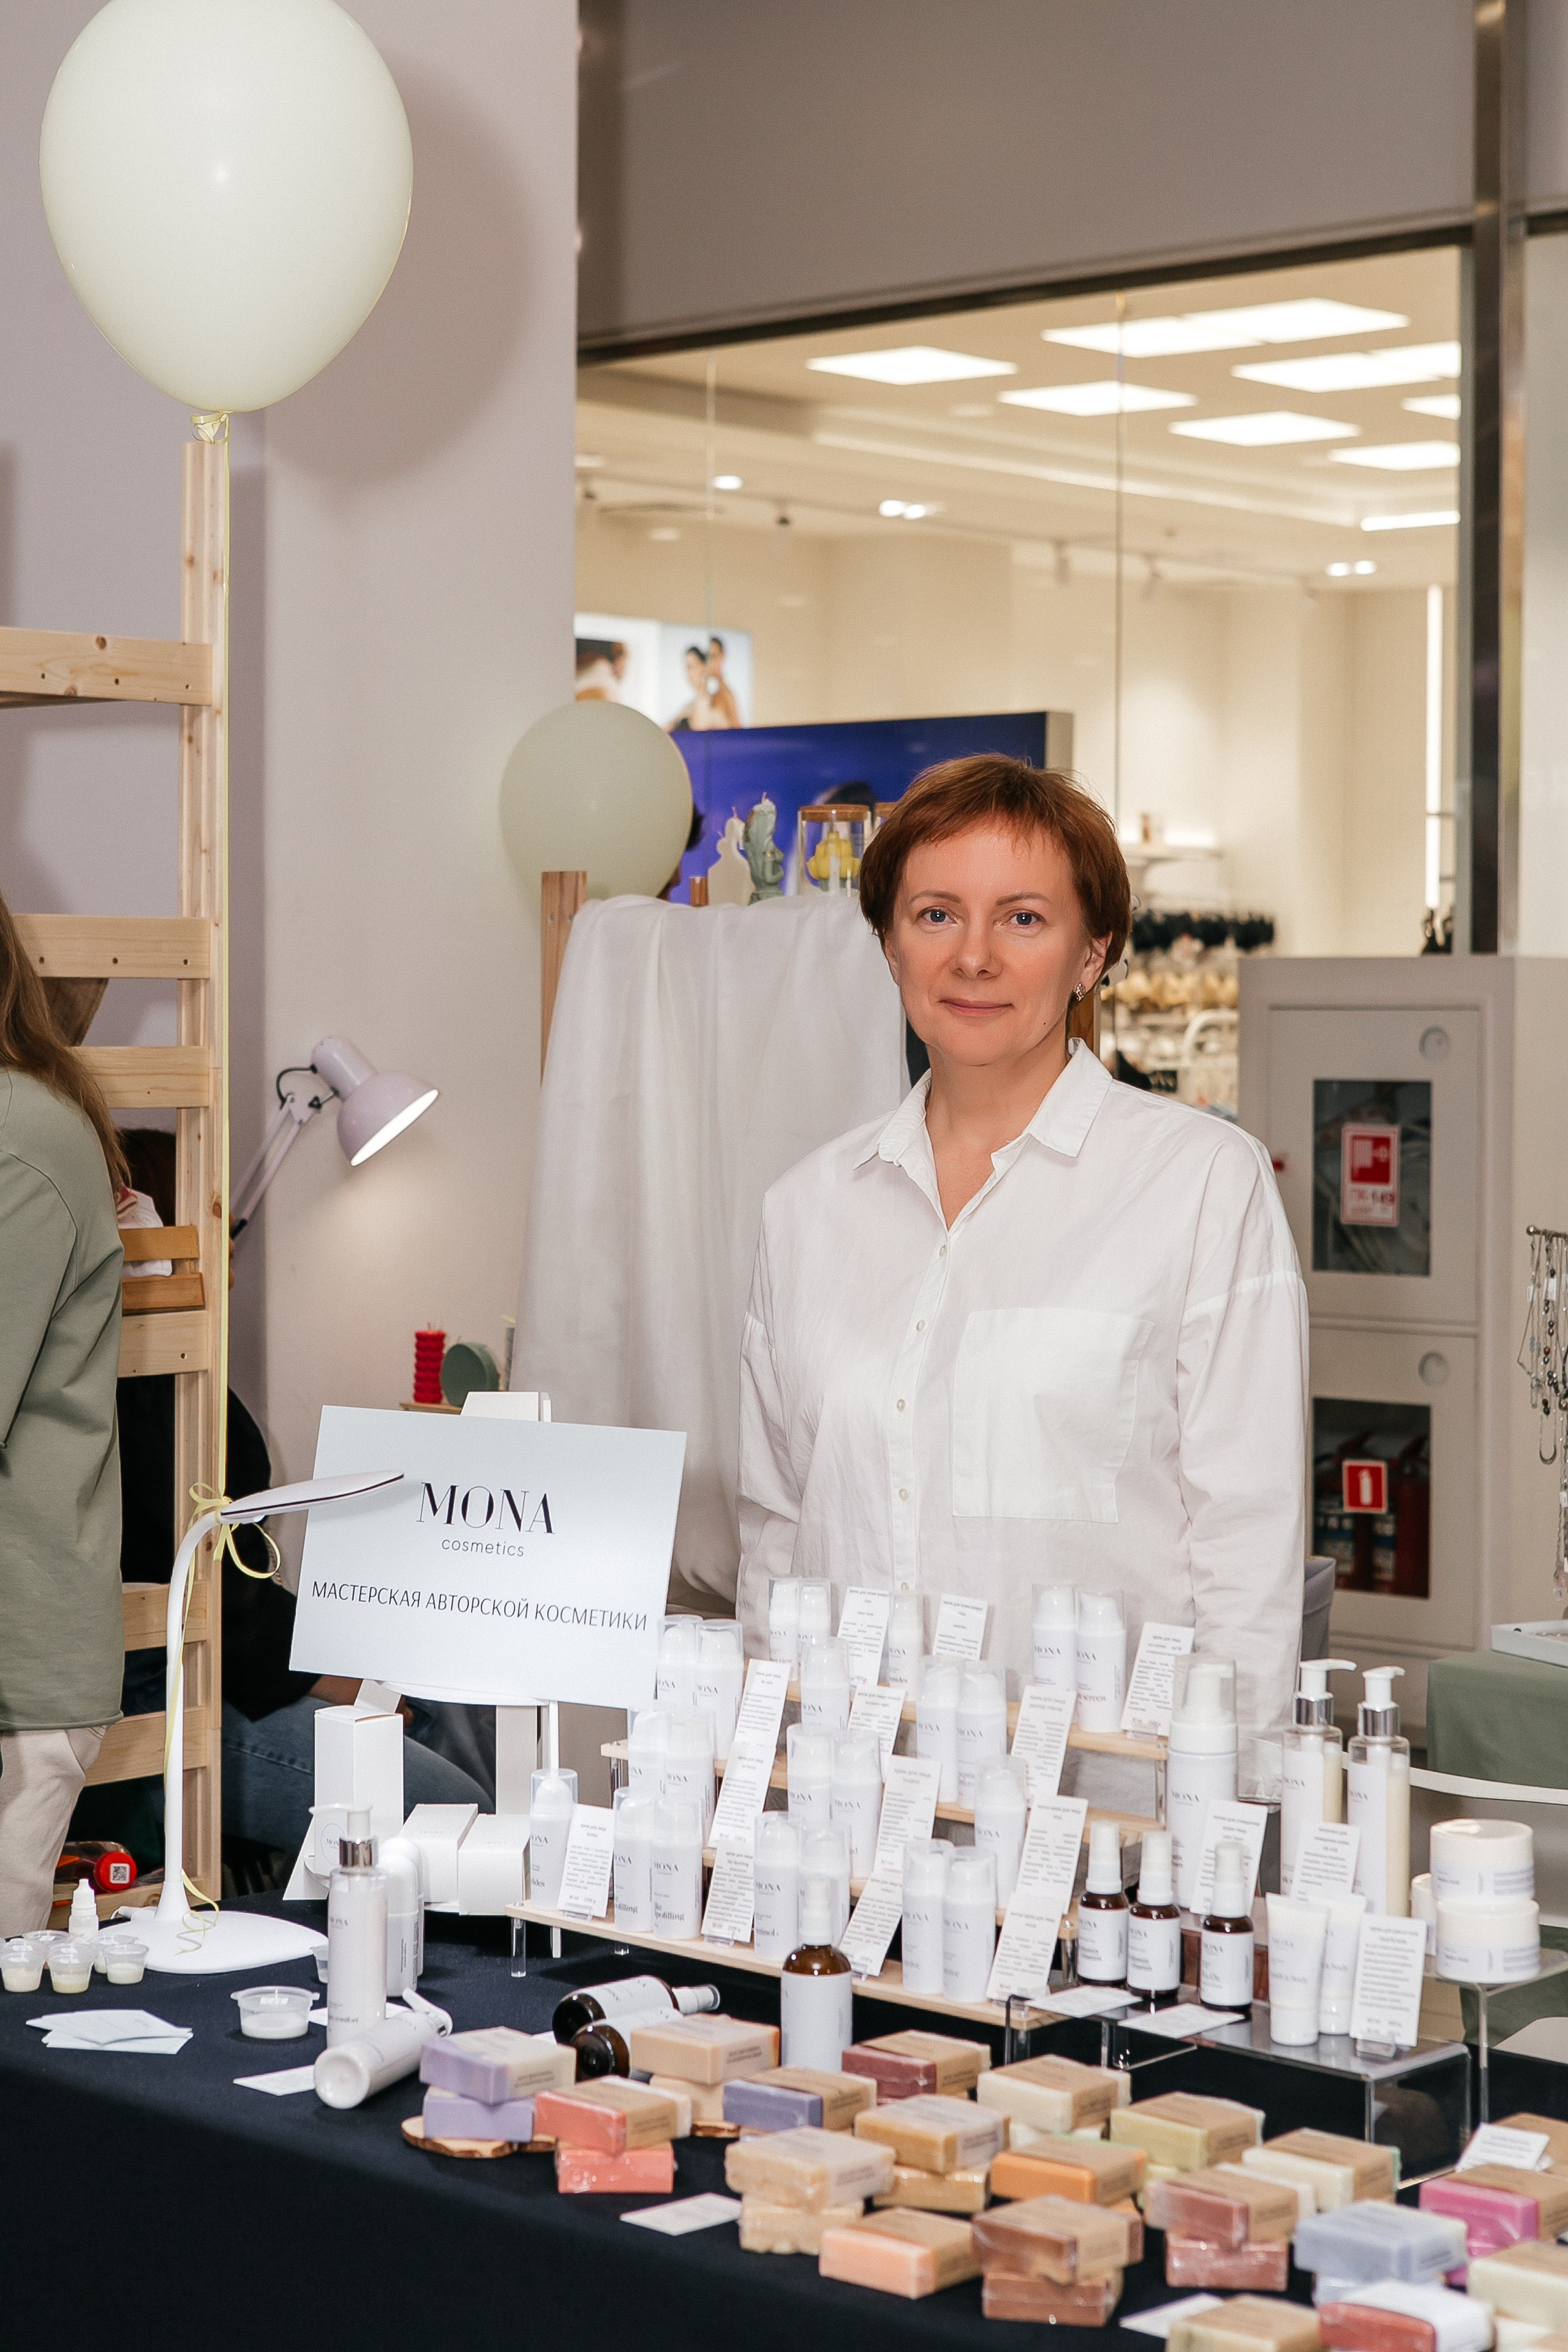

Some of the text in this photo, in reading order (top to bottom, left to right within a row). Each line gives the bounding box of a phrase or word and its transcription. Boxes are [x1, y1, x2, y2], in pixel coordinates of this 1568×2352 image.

[416, 1481, 556, 1535] MONA
[441, 1538, 525, 1558] cosmetics
[311, 1580, 647, 1632] МАСТЕРСКАЯ АВТОРСКОЙ КОСМЕТИКИ
[1076, 1650, 1096, 1661] ONA
[658, 1680, 676, 1689] ONA
[326, 1838, 340, 1847] MON
[531, 1834, 549, 1844] ONA
[614, 1855, 632, 1864] ONA
[654, 1862, 679, 1872] MONA
[755, 1880, 781, 1892] MONA
